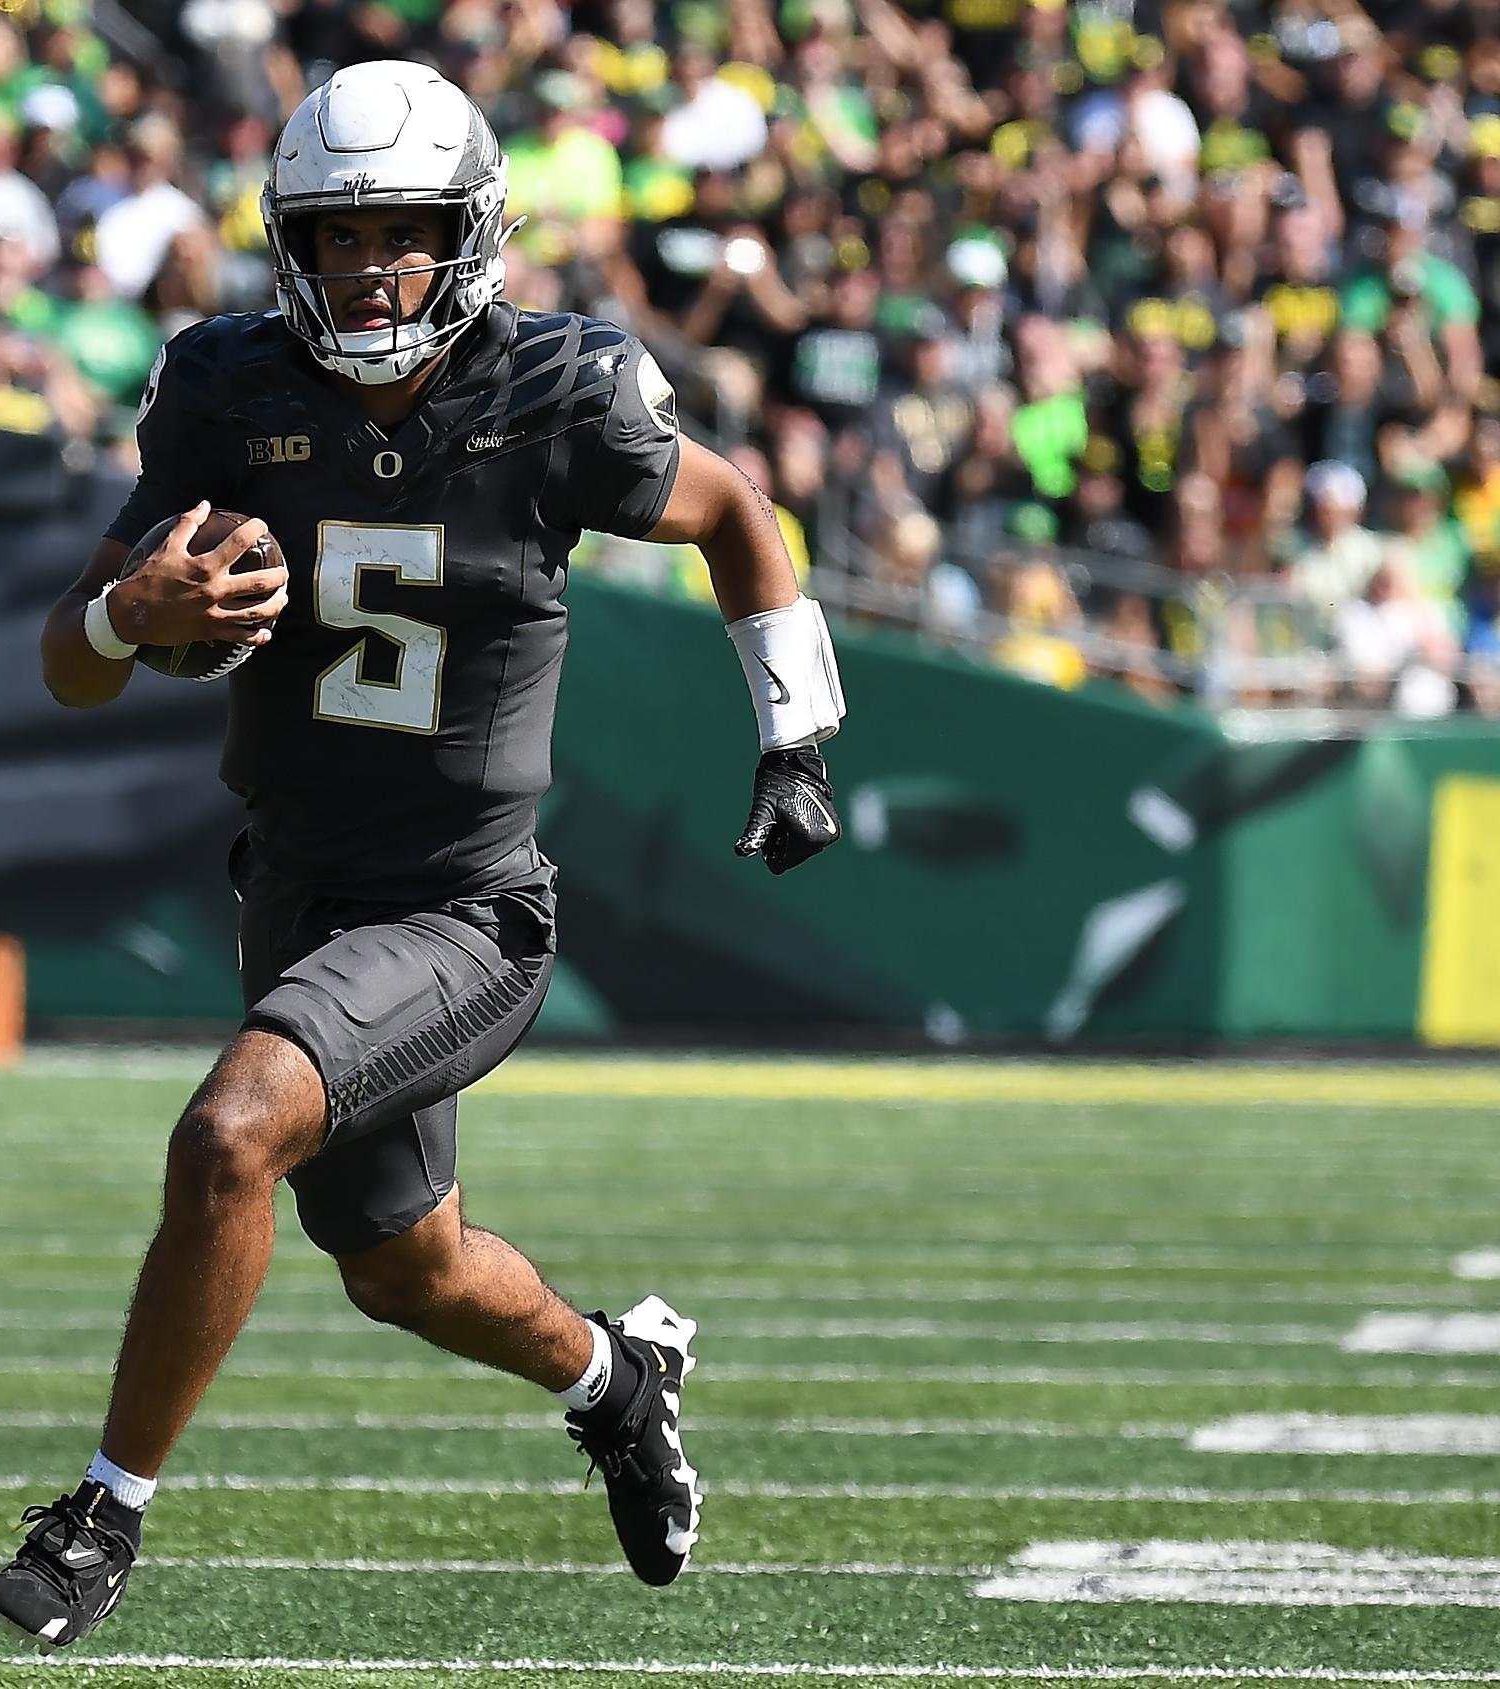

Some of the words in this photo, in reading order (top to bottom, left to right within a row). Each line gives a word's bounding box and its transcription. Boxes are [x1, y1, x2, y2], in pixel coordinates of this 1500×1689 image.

[342, 172, 376, 190] nike
[372, 450, 404, 479] O
[312, 519, 448, 735] 5
